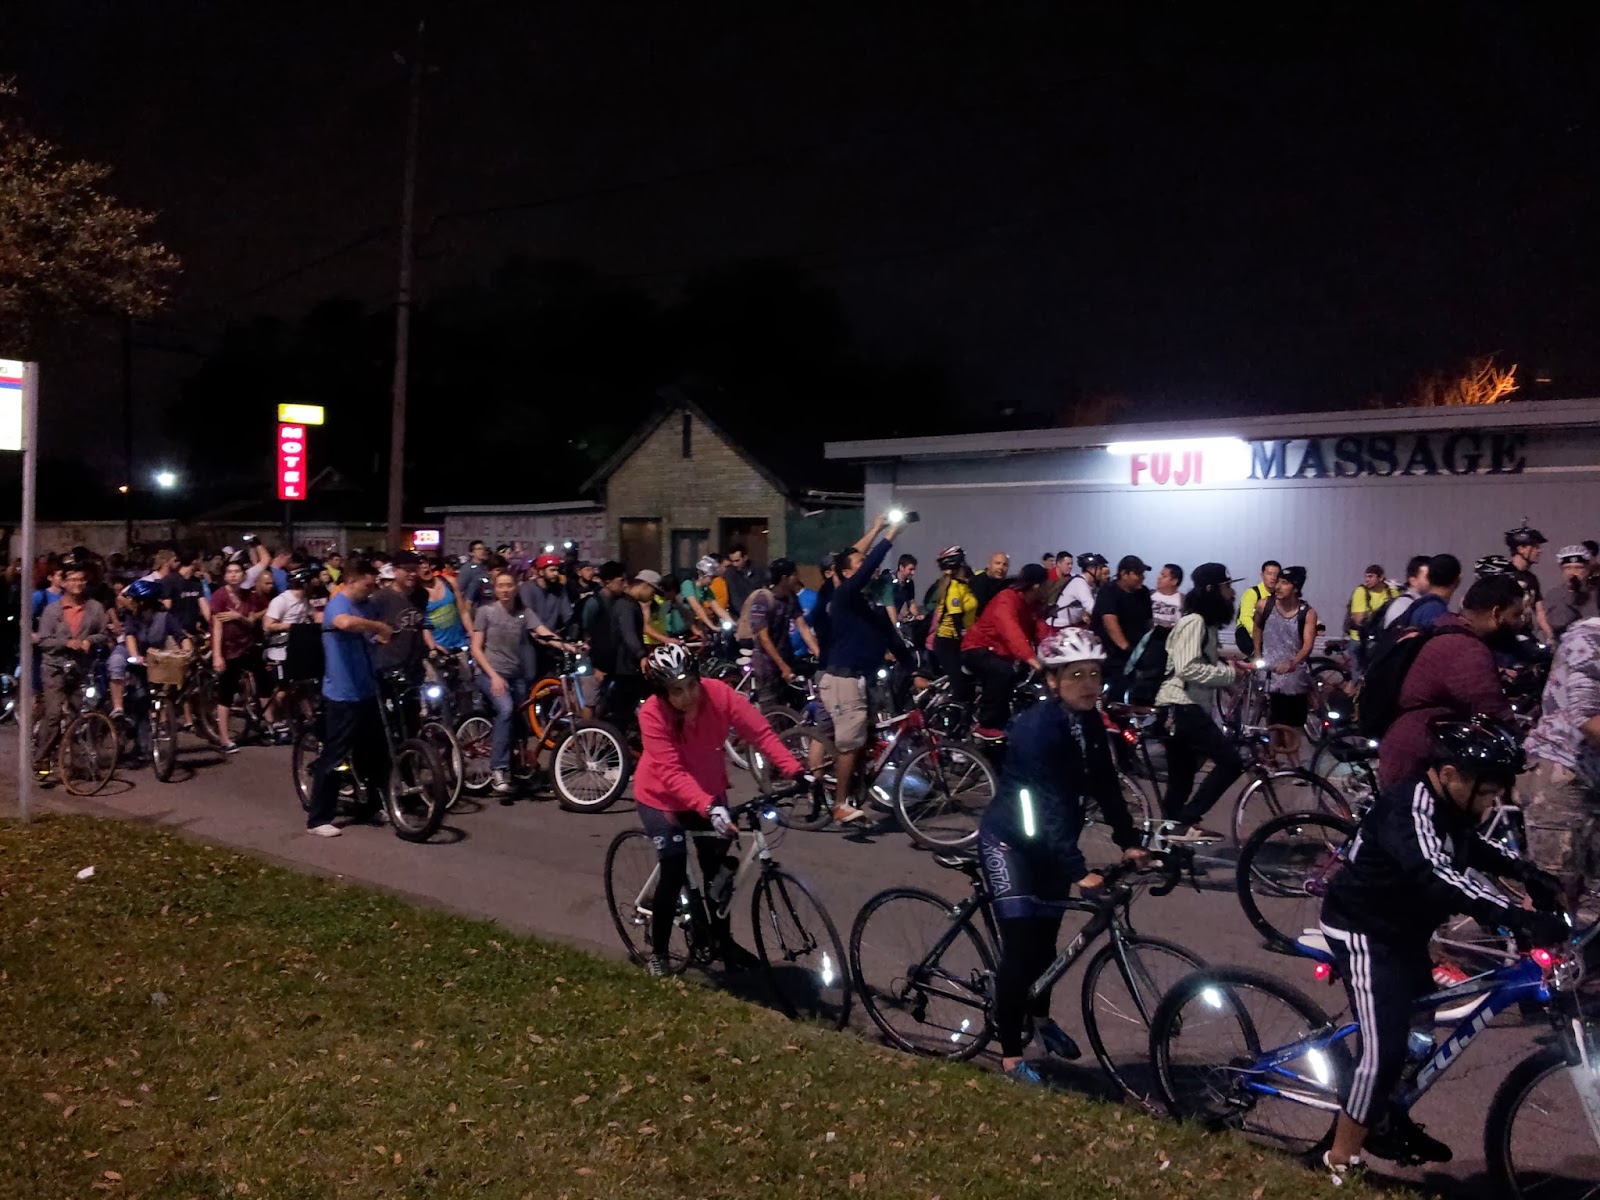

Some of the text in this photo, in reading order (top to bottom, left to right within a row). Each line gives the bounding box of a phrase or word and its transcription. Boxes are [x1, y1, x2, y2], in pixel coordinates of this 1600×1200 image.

[281, 427, 303, 497] MOTEL
[1131, 433, 1527, 485] FUJI MASSAGE
[1417, 1006, 1494, 1090] FUJI
